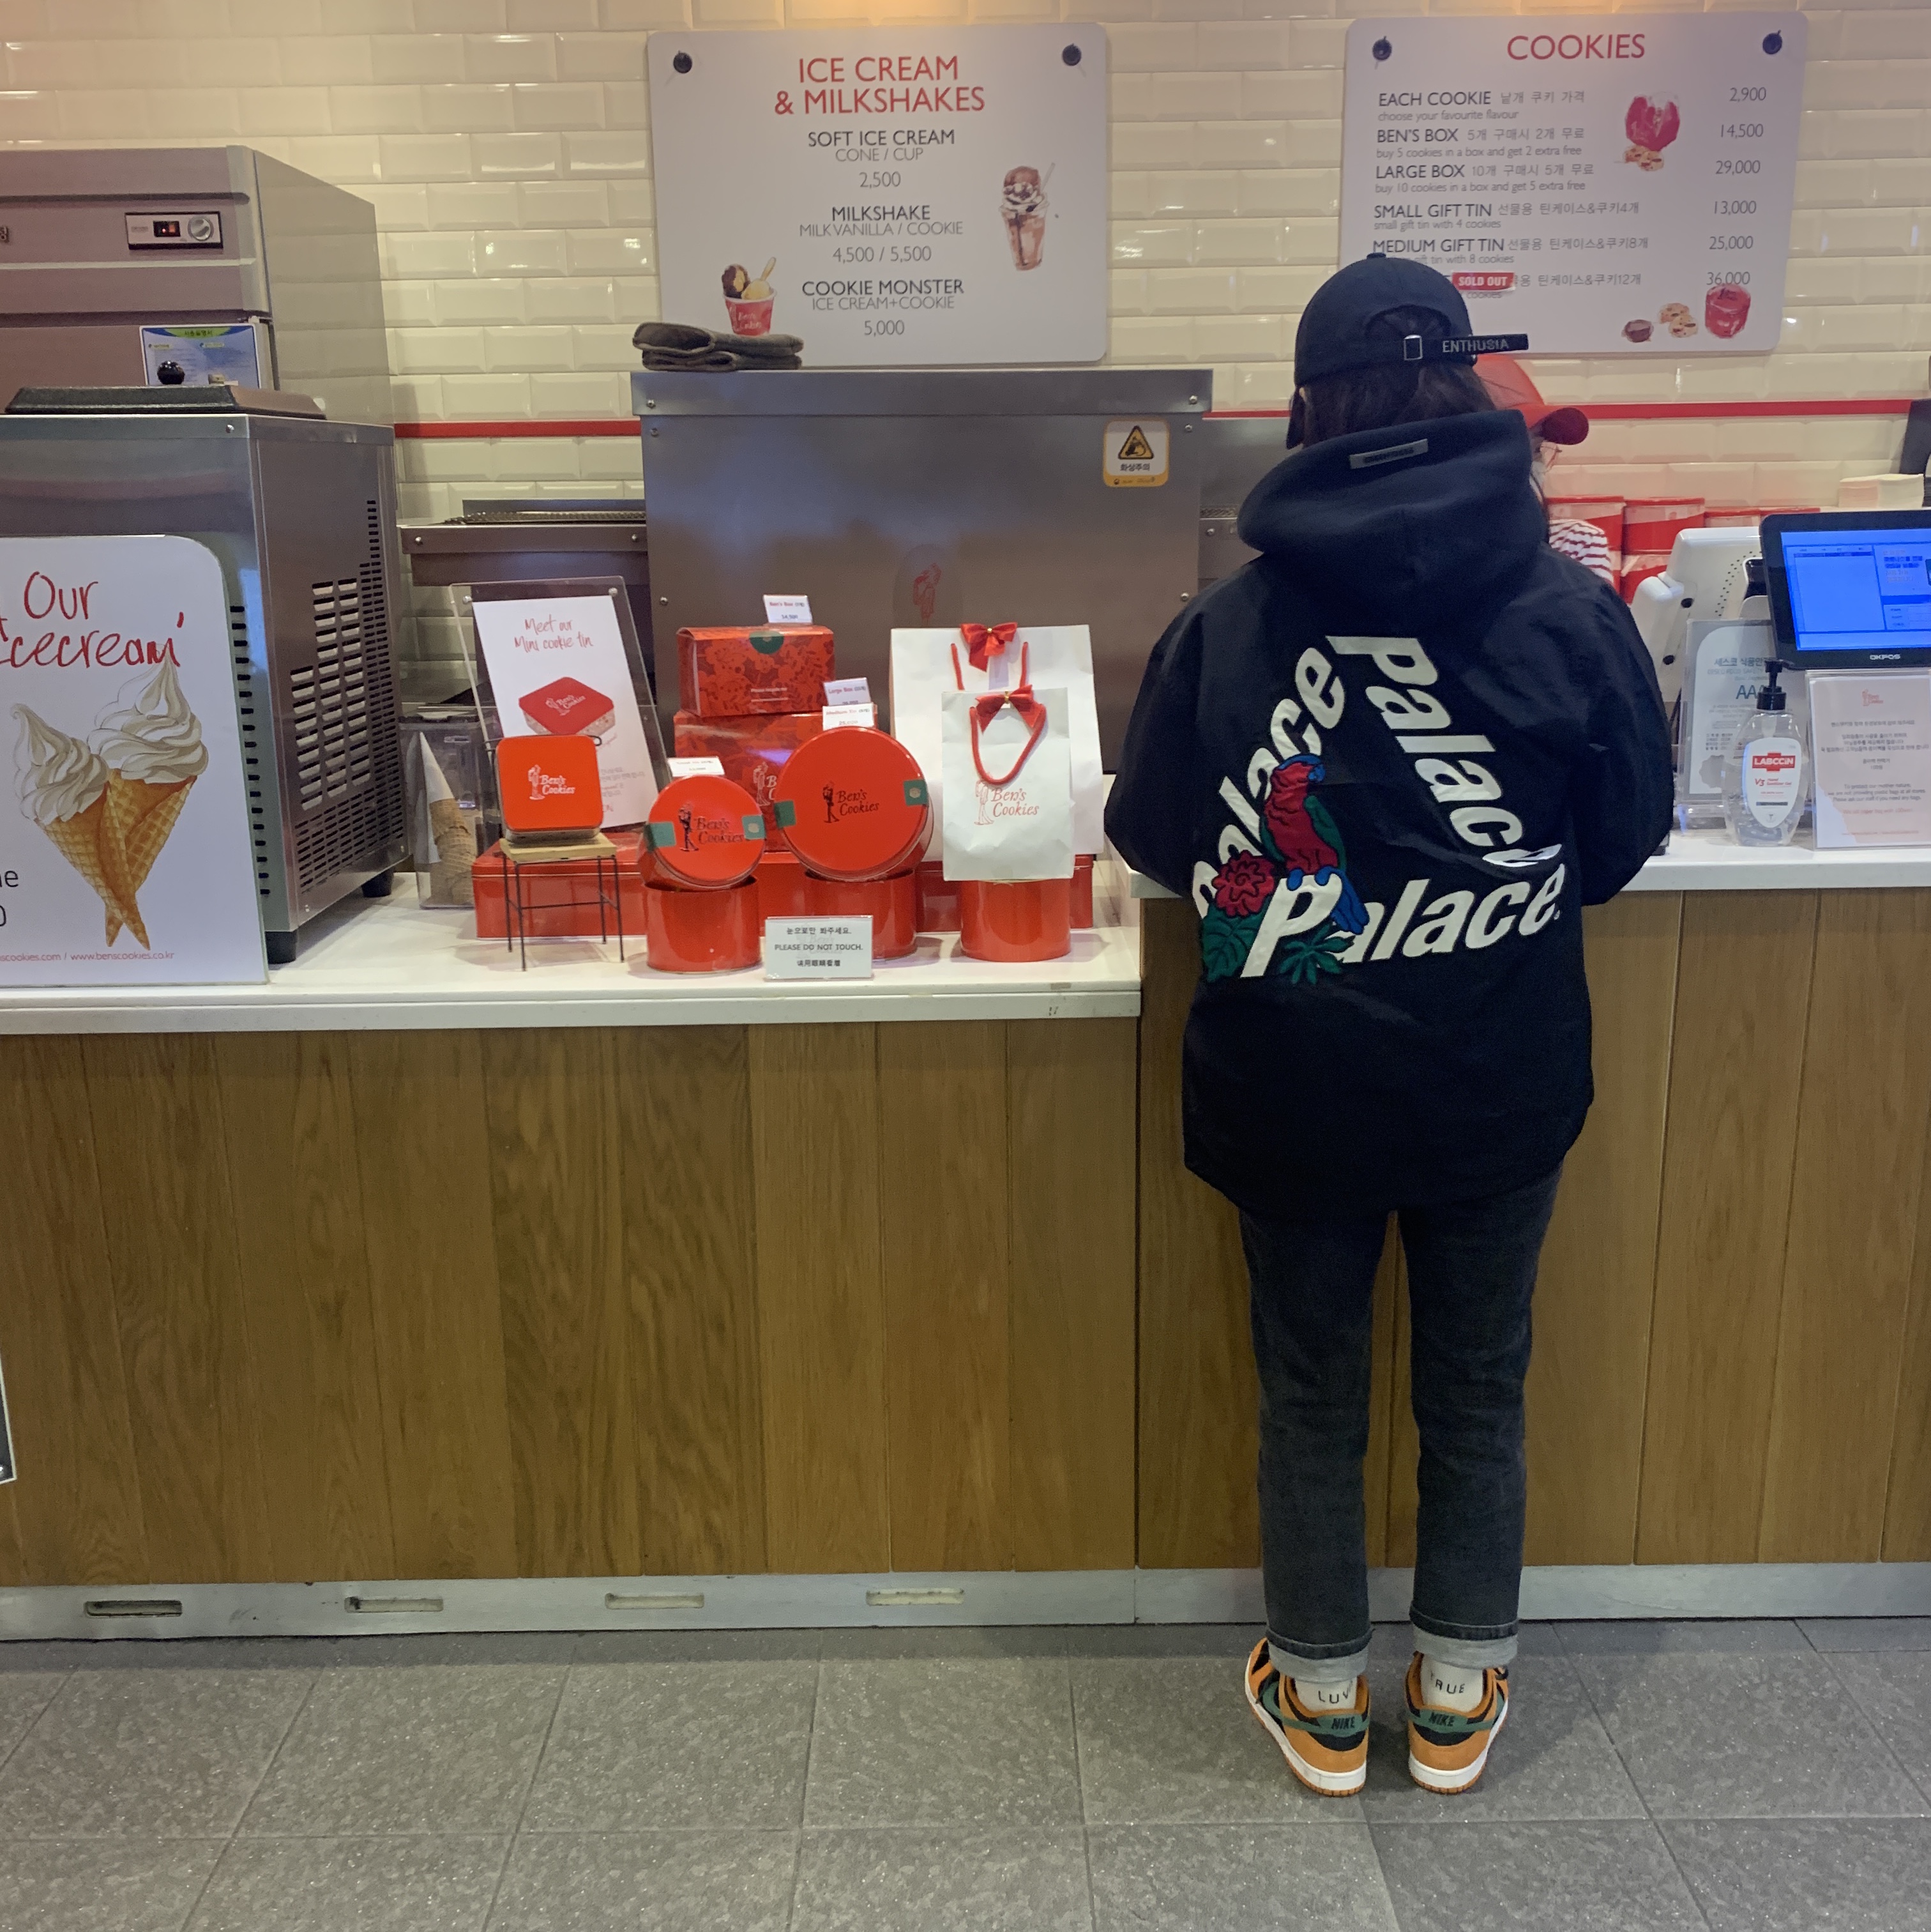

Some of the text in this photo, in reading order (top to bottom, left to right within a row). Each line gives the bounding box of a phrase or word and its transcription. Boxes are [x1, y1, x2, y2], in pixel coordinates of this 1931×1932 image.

[1507, 34, 1645, 60] COOKIES
[799, 56, 958, 83] ICE CREAM
[775, 86, 985, 115] & MILKSHAKES
[1379, 93, 1421, 107] EACH
[1427, 91, 1491, 105] COOKIE
[1531, 91, 1554, 103] 쿠키
[1561, 91, 1585, 103] 가격
[1729, 87, 1766, 102] 2,900
[1378, 109, 1519, 123] choose your favourite flavour
[808, 129, 955, 147] SOFT ICE CREAM
[1377, 129, 1419, 142] BEN'S
[1425, 128, 1458, 142] BOX
[1467, 128, 1487, 141] 5개
[1536, 128, 1554, 140] 2개
[1562, 128, 1584, 139] 무료
[1721, 123, 1764, 139] 14,500
[835, 147, 923, 162] CONE / CUP
[1376, 148, 1394, 160] buy
[1397, 148, 1403, 158] 5
[1406, 148, 1442, 158] cookies
[1445, 147, 1454, 156] in
[1465, 146, 1484, 156] box
[1487, 146, 1505, 156] and
[1507, 148, 1522, 158] get
[1526, 146, 1531, 156] 2
[1535, 146, 1560, 156] extra
[1563, 145, 1582, 155] free
[1375, 165, 1427, 179] LARGE
[1432, 164, 1465, 178] BOX
[1472, 165, 1496, 177] 10개
[1545, 164, 1564, 176] 5개
[1571, 164, 1594, 175] 무료
[1715, 160, 1761, 176] 29,000
[859, 171, 901, 190] 2,500
[1375, 183, 1393, 195] buy
[1397, 183, 1408, 192] 10
[1411, 183, 1447, 192] cookies
[1450, 183, 1458, 192] in
[1469, 181, 1488, 191] box
[1490, 181, 1508, 191] and
[1511, 183, 1526, 194] get
[1530, 181, 1536, 190] 5
[1539, 181, 1564, 190] extra
[1567, 181, 1586, 190] free
[832, 205, 931, 221] MILKSHAKE
[1374, 204, 1422, 218] SMALL
[1428, 204, 1462, 217] GIFT
[1465, 203, 1491, 217] TIN
[1714, 201, 1757, 215] 13,000
[799, 222, 963, 236] MILK VANILLA / COOKIE
[1374, 218, 1501, 232] small gift tin with 4 cookies
[1373, 240, 1435, 253] MEDIUM
[1441, 239, 1474, 252] GIFT
[1478, 239, 1504, 251] TIN
[1709, 236, 1753, 250] 25,000
[832, 246, 932, 263] 4,500 / 5,500
[1431, 254, 1514, 264] tin with 8 cookies
[1458, 277, 1484, 286] SOLD
[1487, 277, 1508, 286] OUT
[1706, 271, 1751, 286] 36,000
[802, 279, 964, 296] COOKIE MONSTER
[812, 296, 955, 310] ICE CREAM+COOKIE
[864, 319, 905, 337] 5,000
[1443, 339, 1510, 353] ENTHUSIA
[24, 571, 98, 620] Our
[525, 614, 557, 635] Meet
[514, 631, 594, 653] Mini cookie tin
[1326, 635, 1563, 867] Palace
[539, 775, 575, 795] Ben's Cookies
[837, 789, 879, 816] Ben's Cookies
[990, 788, 1040, 817] Ben's Cookies
[694, 816, 729, 830] Ben's
[699, 830, 743, 845] Cookies
[70, 951, 174, 961] www.benscookies.co.kr
[1331, 1716, 1355, 1730] NIKE
[1428, 1712, 1455, 1727] NIKE
